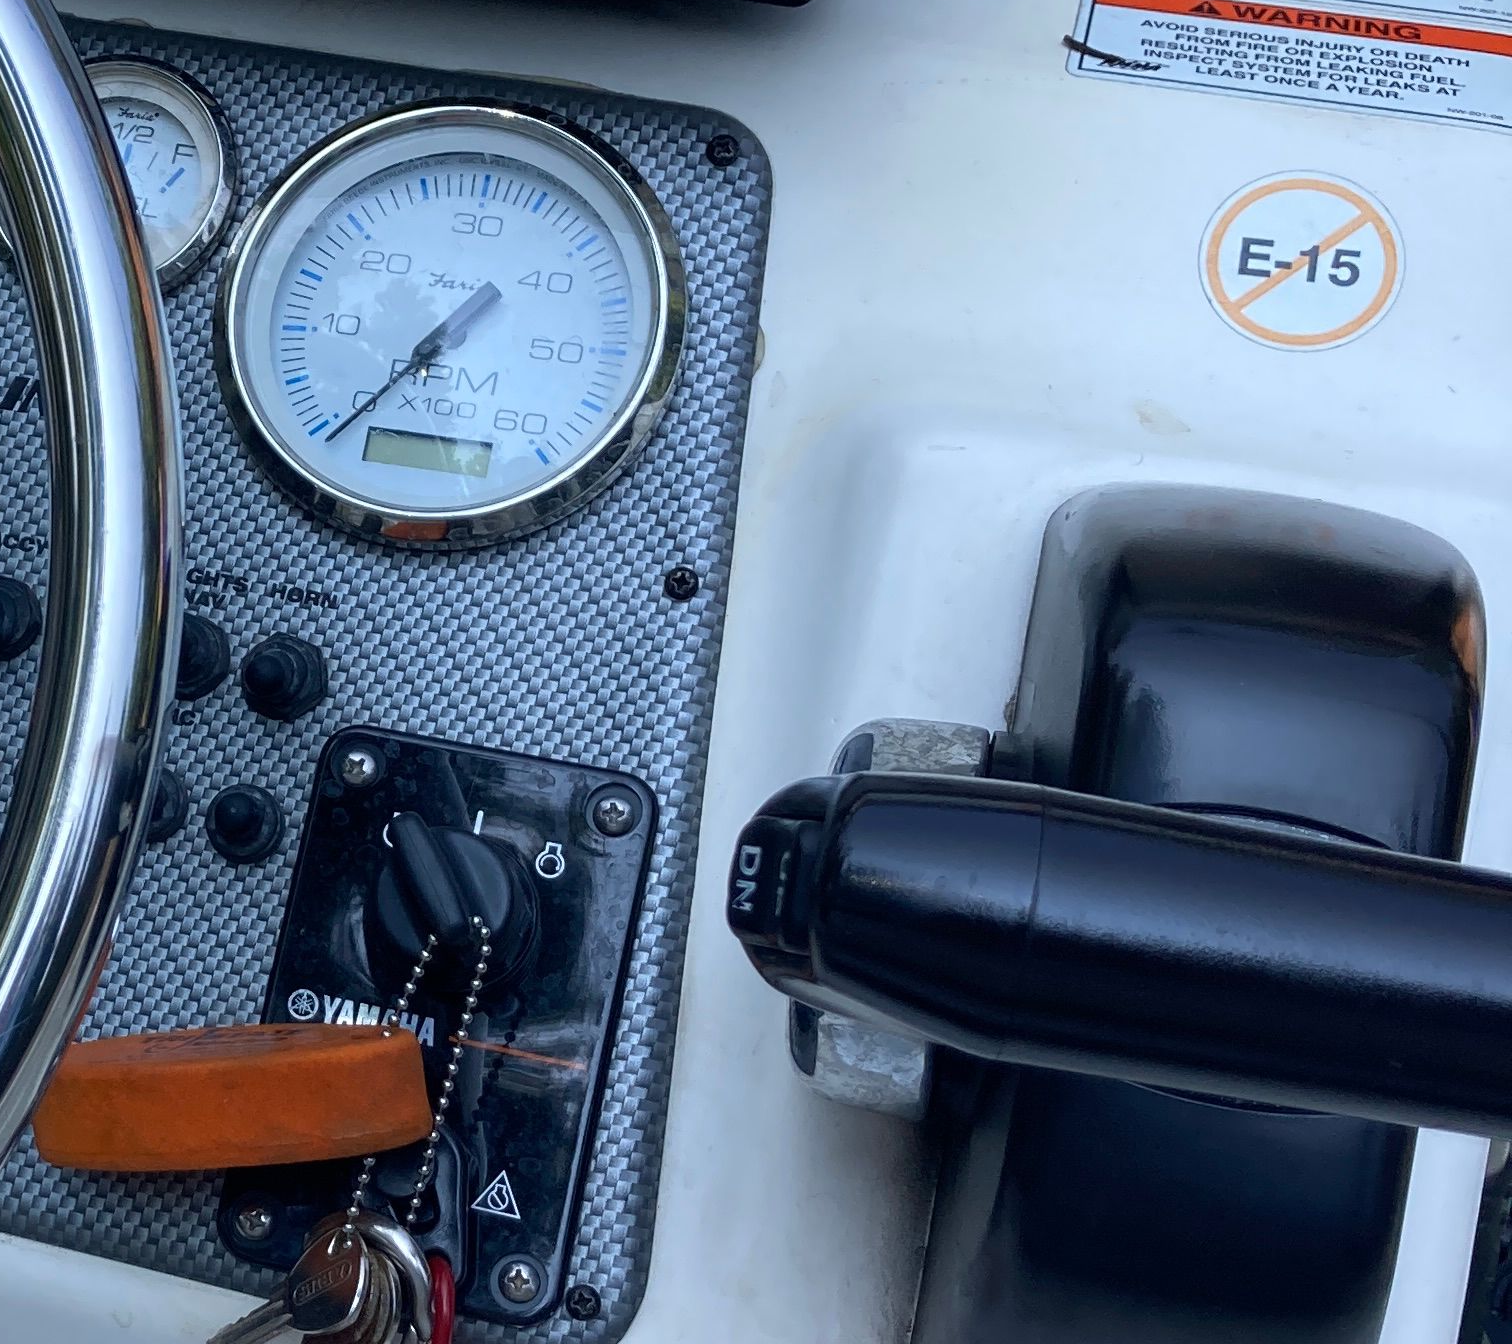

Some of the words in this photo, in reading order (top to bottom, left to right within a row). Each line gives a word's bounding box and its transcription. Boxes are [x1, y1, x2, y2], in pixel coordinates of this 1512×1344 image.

[1232, 4, 1421, 40] WARNING
[1140, 20, 1199, 33] AVOID
[1204, 27, 1290, 44] SERIOUS
[1295, 38, 1365, 54] INJURY
[1369, 47, 1398, 58] OR
[1405, 51, 1470, 68] DEATH
[1175, 33, 1230, 47] FROM
[1236, 41, 1279, 53] FIRE
[1285, 46, 1314, 57] OR
[1319, 51, 1433, 73] EXPLOSION
[1140, 38, 1248, 59] RESULTING
[1254, 53, 1311, 68] FROM
[1317, 61, 1404, 80] LEAKING
[1144, 49, 1226, 67] INSPECT
[1232, 60, 1311, 78] SYSTEM
[1317, 71, 1358, 84] FOR
[1364, 77, 1430, 94] LEAKS
[1436, 87, 1462, 98] AT
[1195, 66, 1259, 81] LEAST
[1264, 75, 1320, 90] ONCE
[1325, 83, 1340, 92] A
[1345, 84, 1405, 101] YEAR.
[113, 122, 155, 144] 1/2
[172, 143, 196, 164] F
[452, 212, 503, 237] 30
[360, 250, 412, 274] 20
[1237, 236, 1361, 287] E-15
[428, 272, 480, 291] Fari
[517, 270, 573, 294] 40
[322, 312, 361, 335] 10
[529, 338, 584, 364] 50
[390, 359, 499, 396] RPM
[398, 394, 477, 419] X100
[493, 409, 548, 435] 60
[271, 582, 338, 607] HORN
[732, 844, 763, 912] DN
